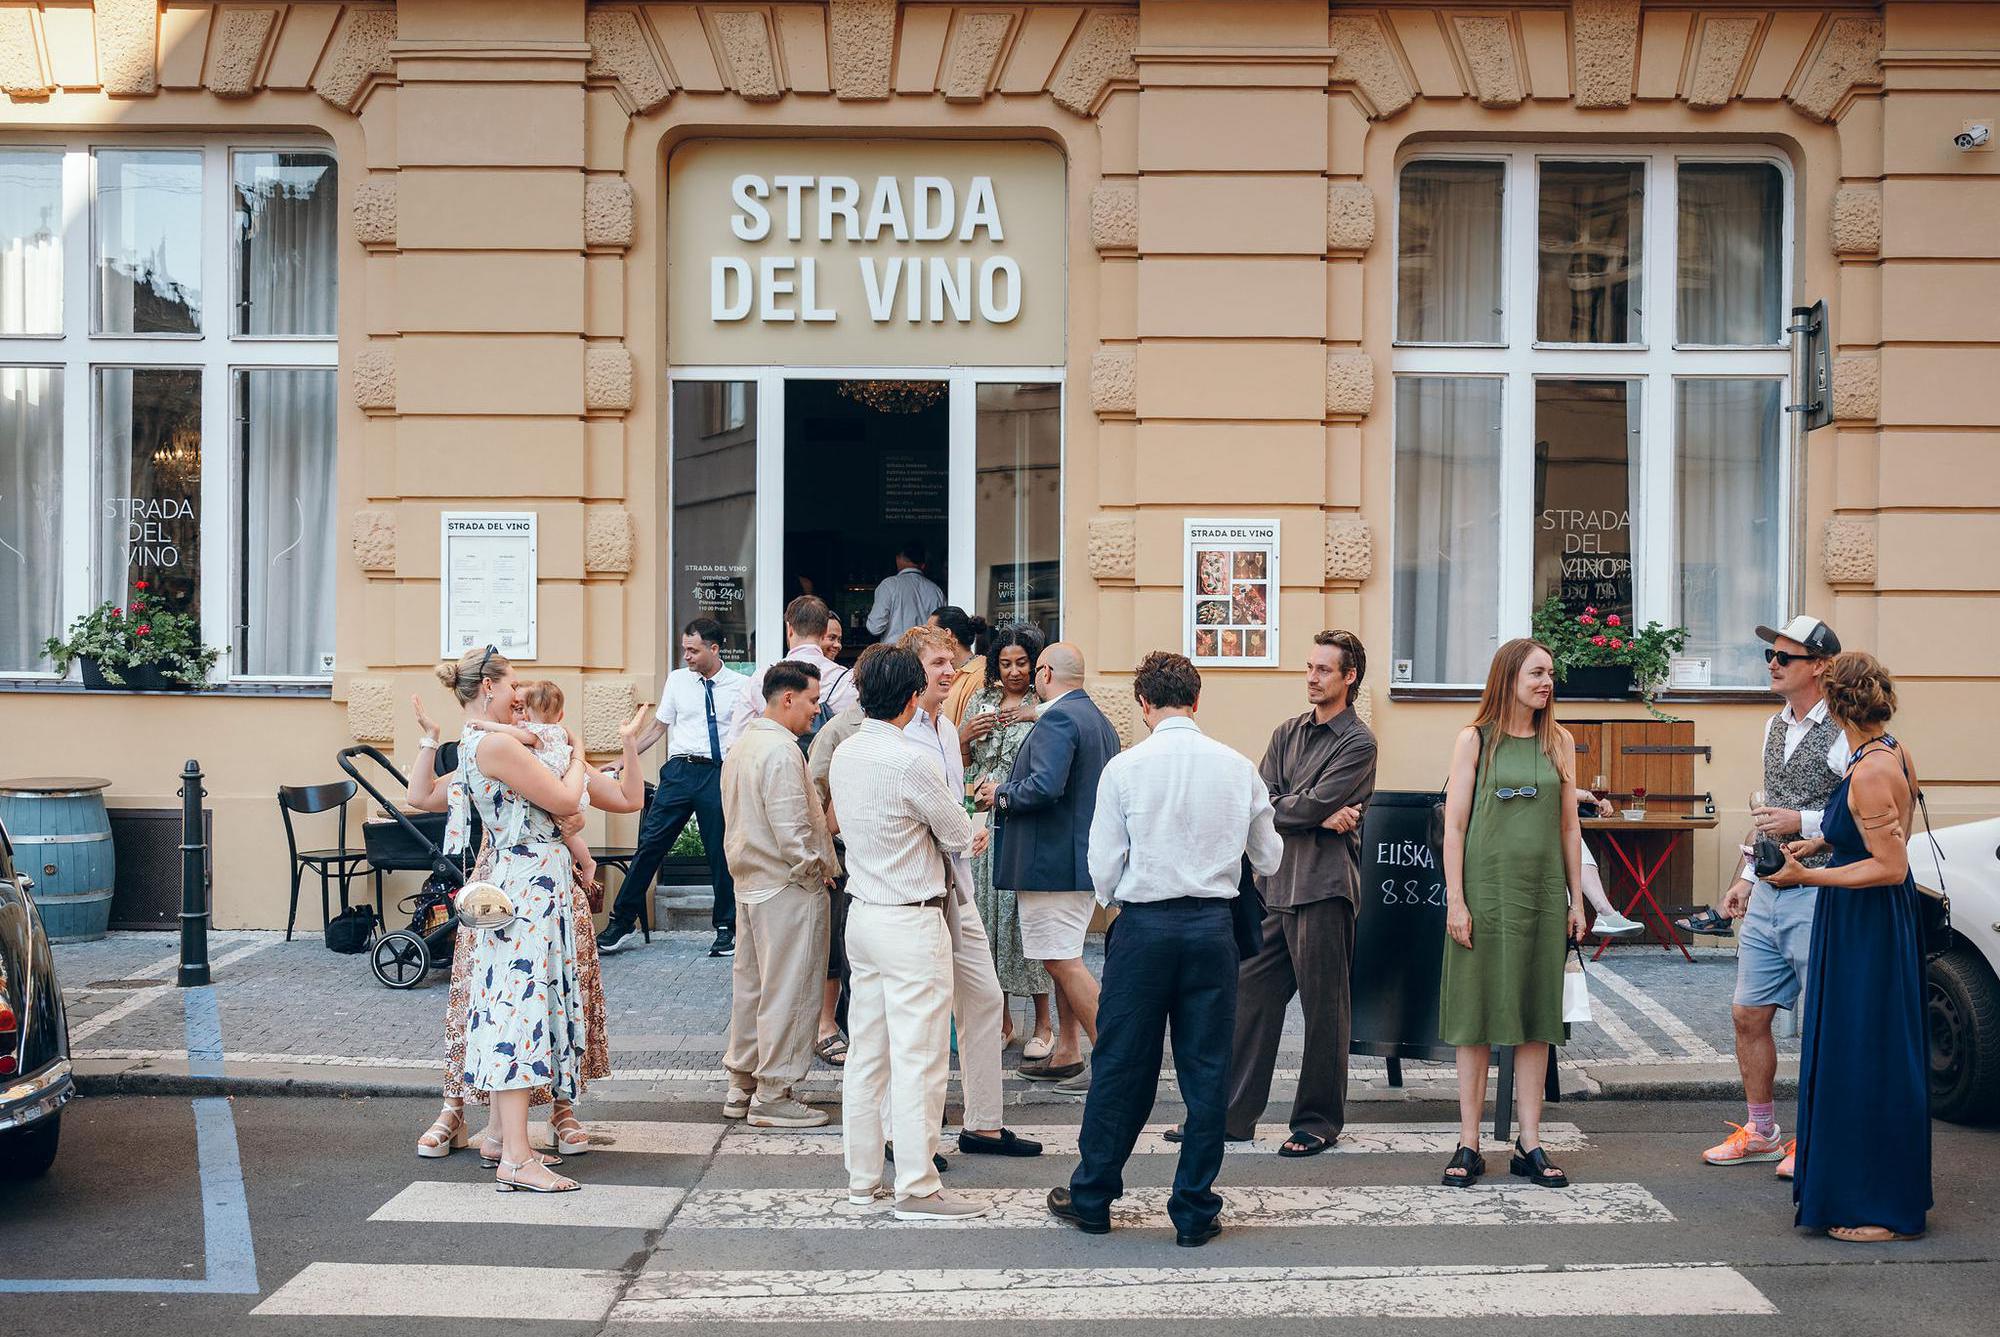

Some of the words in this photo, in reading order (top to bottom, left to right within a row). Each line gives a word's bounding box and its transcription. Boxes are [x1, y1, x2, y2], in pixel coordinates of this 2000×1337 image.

[730, 174, 1005, 242] STRADA
[711, 256, 838, 322] DEL
[859, 255, 1022, 323] VINO
[104, 498, 194, 519] STRADA
[448, 522, 485, 531] STRADA
[487, 522, 504, 531] DEL
[507, 522, 530, 531] VINO
[1542, 509, 1631, 530] STRADA
[128, 522, 171, 542] DEL
[1191, 529, 1228, 538] STRADA
[1230, 529, 1247, 538] DEL
[1249, 529, 1274, 538] VINO
[1565, 533, 1610, 554] DEL
[121, 546, 178, 567] VINO
[1559, 557, 1617, 578] VINO
[998, 582, 1016, 590] FRE
[1377, 840, 1434, 869] ELIŠKA
